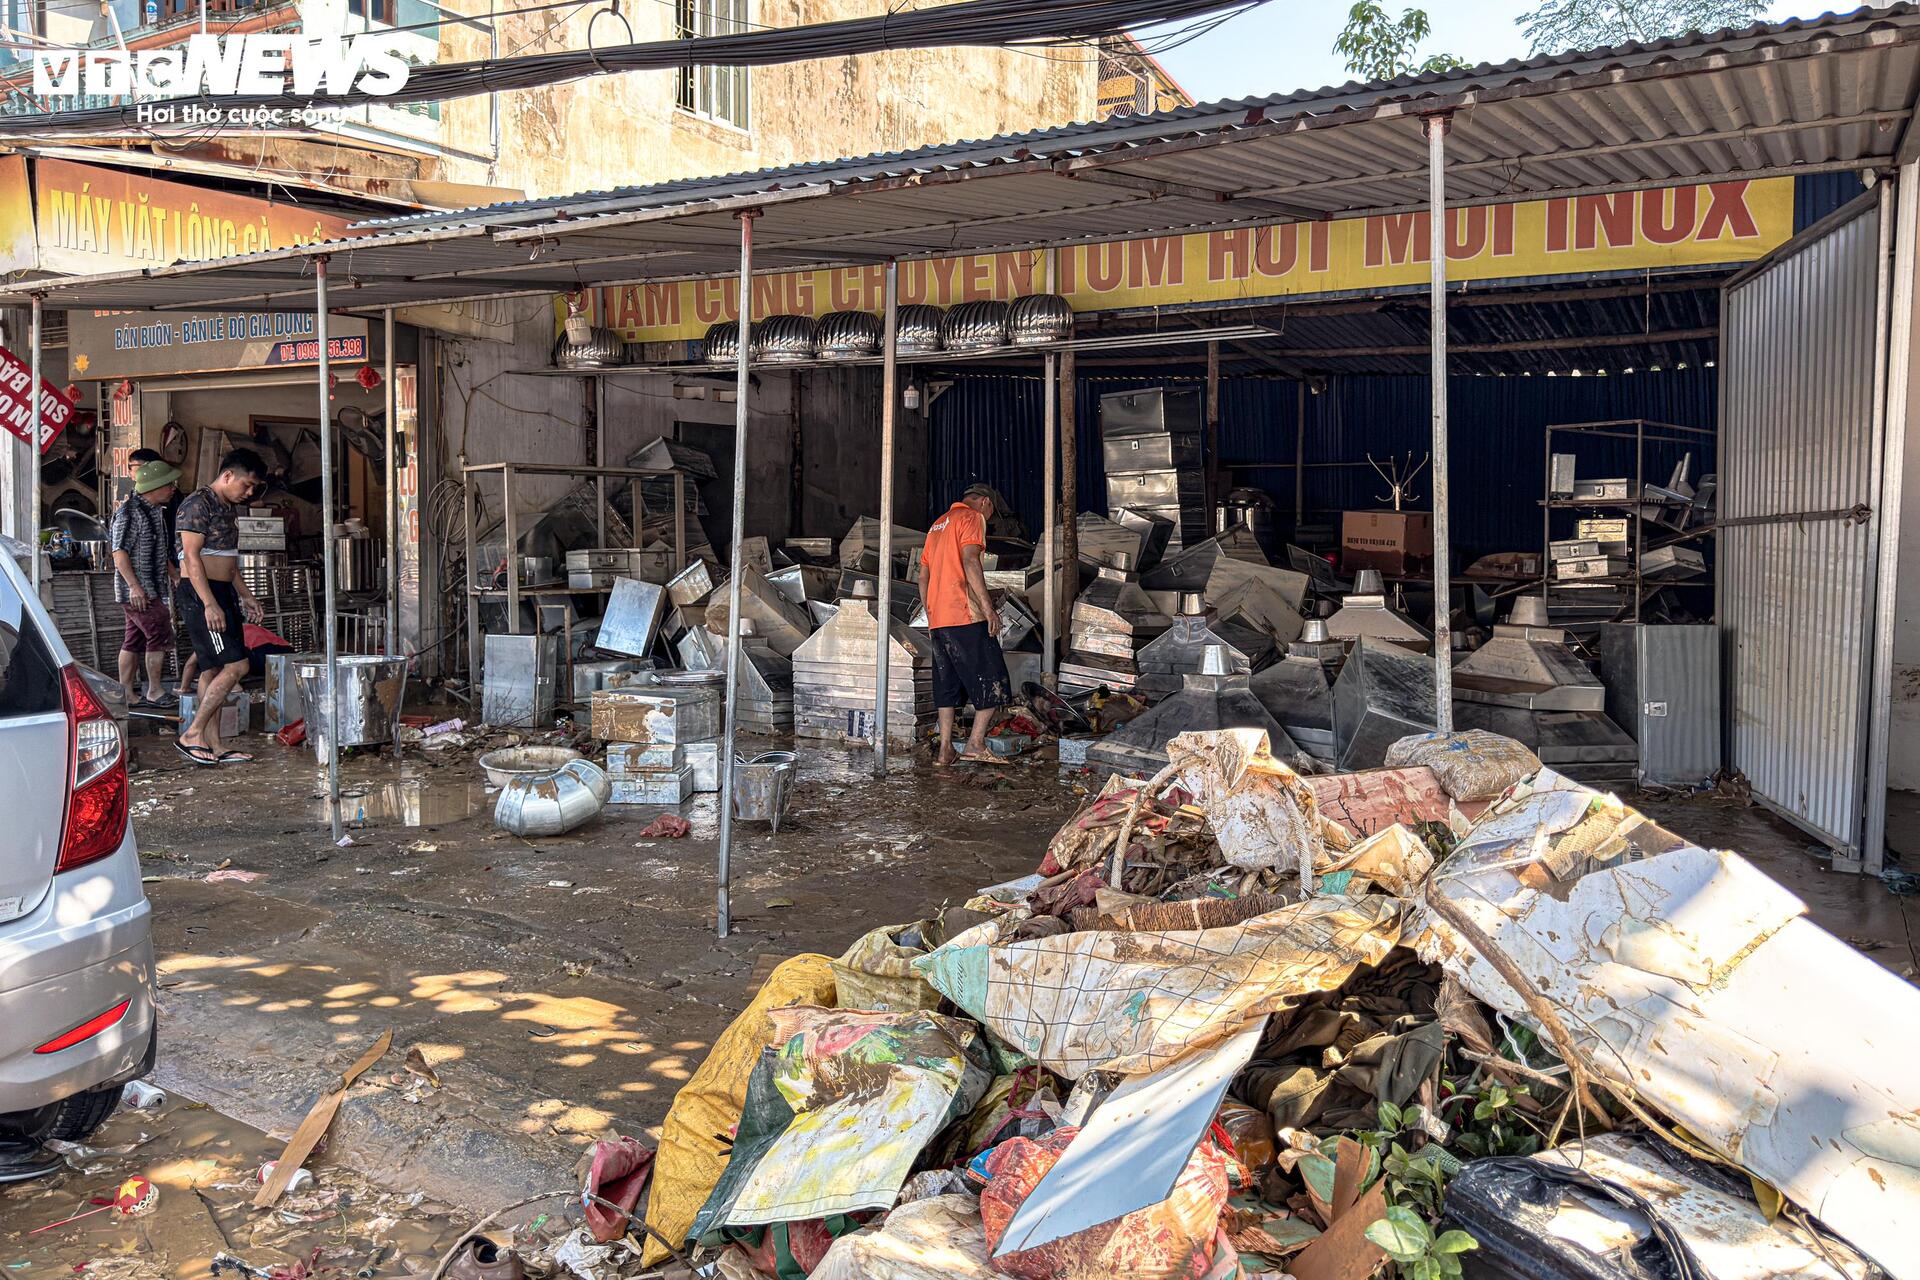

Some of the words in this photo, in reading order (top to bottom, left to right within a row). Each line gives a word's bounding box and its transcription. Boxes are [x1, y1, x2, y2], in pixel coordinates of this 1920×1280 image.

[51, 182, 112, 255] MÁY
[174, 202, 237, 260] LÔNG
[115, 322, 138, 350] BÁN
[140, 320, 172, 348] BUÔN
[182, 315, 207, 344] BÁN
[274, 312, 315, 341] DỤNG
